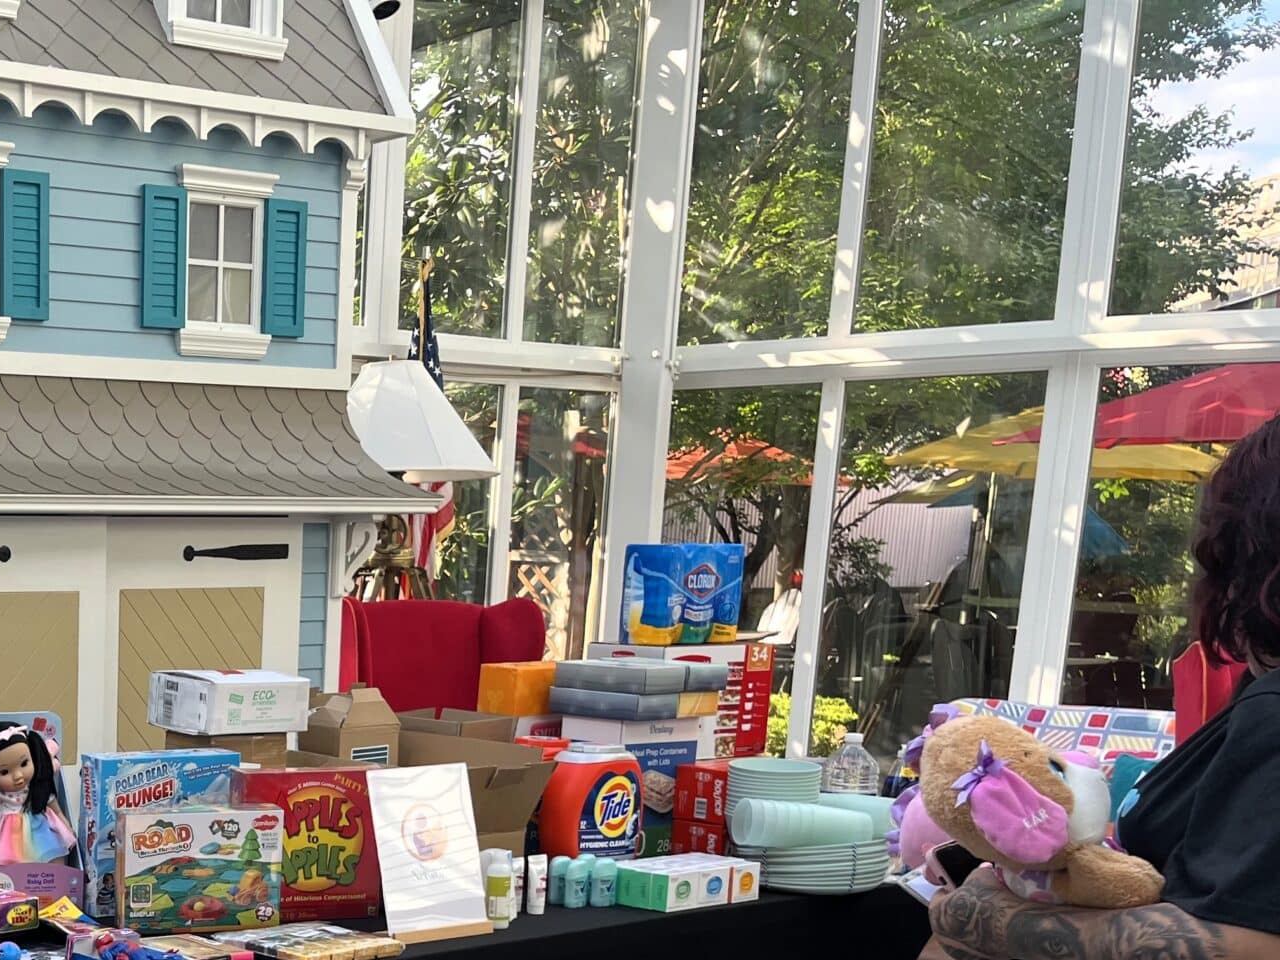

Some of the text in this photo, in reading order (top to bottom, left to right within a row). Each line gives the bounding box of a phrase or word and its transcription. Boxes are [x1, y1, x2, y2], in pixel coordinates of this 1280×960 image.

[687, 573, 716, 589] CLOROX
[751, 645, 768, 662] 34
[660, 747, 688, 757] Containers
[115, 763, 169, 793] POLAR BEAR
[334, 773, 362, 794] PARTY
[115, 778, 175, 809] PLUNGE!
[712, 779, 724, 817] bounce
[277, 790, 362, 839] APPLES
[599, 791, 631, 828] Tide
[1022, 808, 1049, 830] EAR
[223, 822, 239, 832] 120
[132, 825, 192, 853] ROAD
[307, 833, 319, 844] to
[579, 841, 609, 849] HYGIENIC
[656, 839, 670, 853] 28
[281, 843, 361, 886] APPLES
[257, 906, 272, 917] 28
